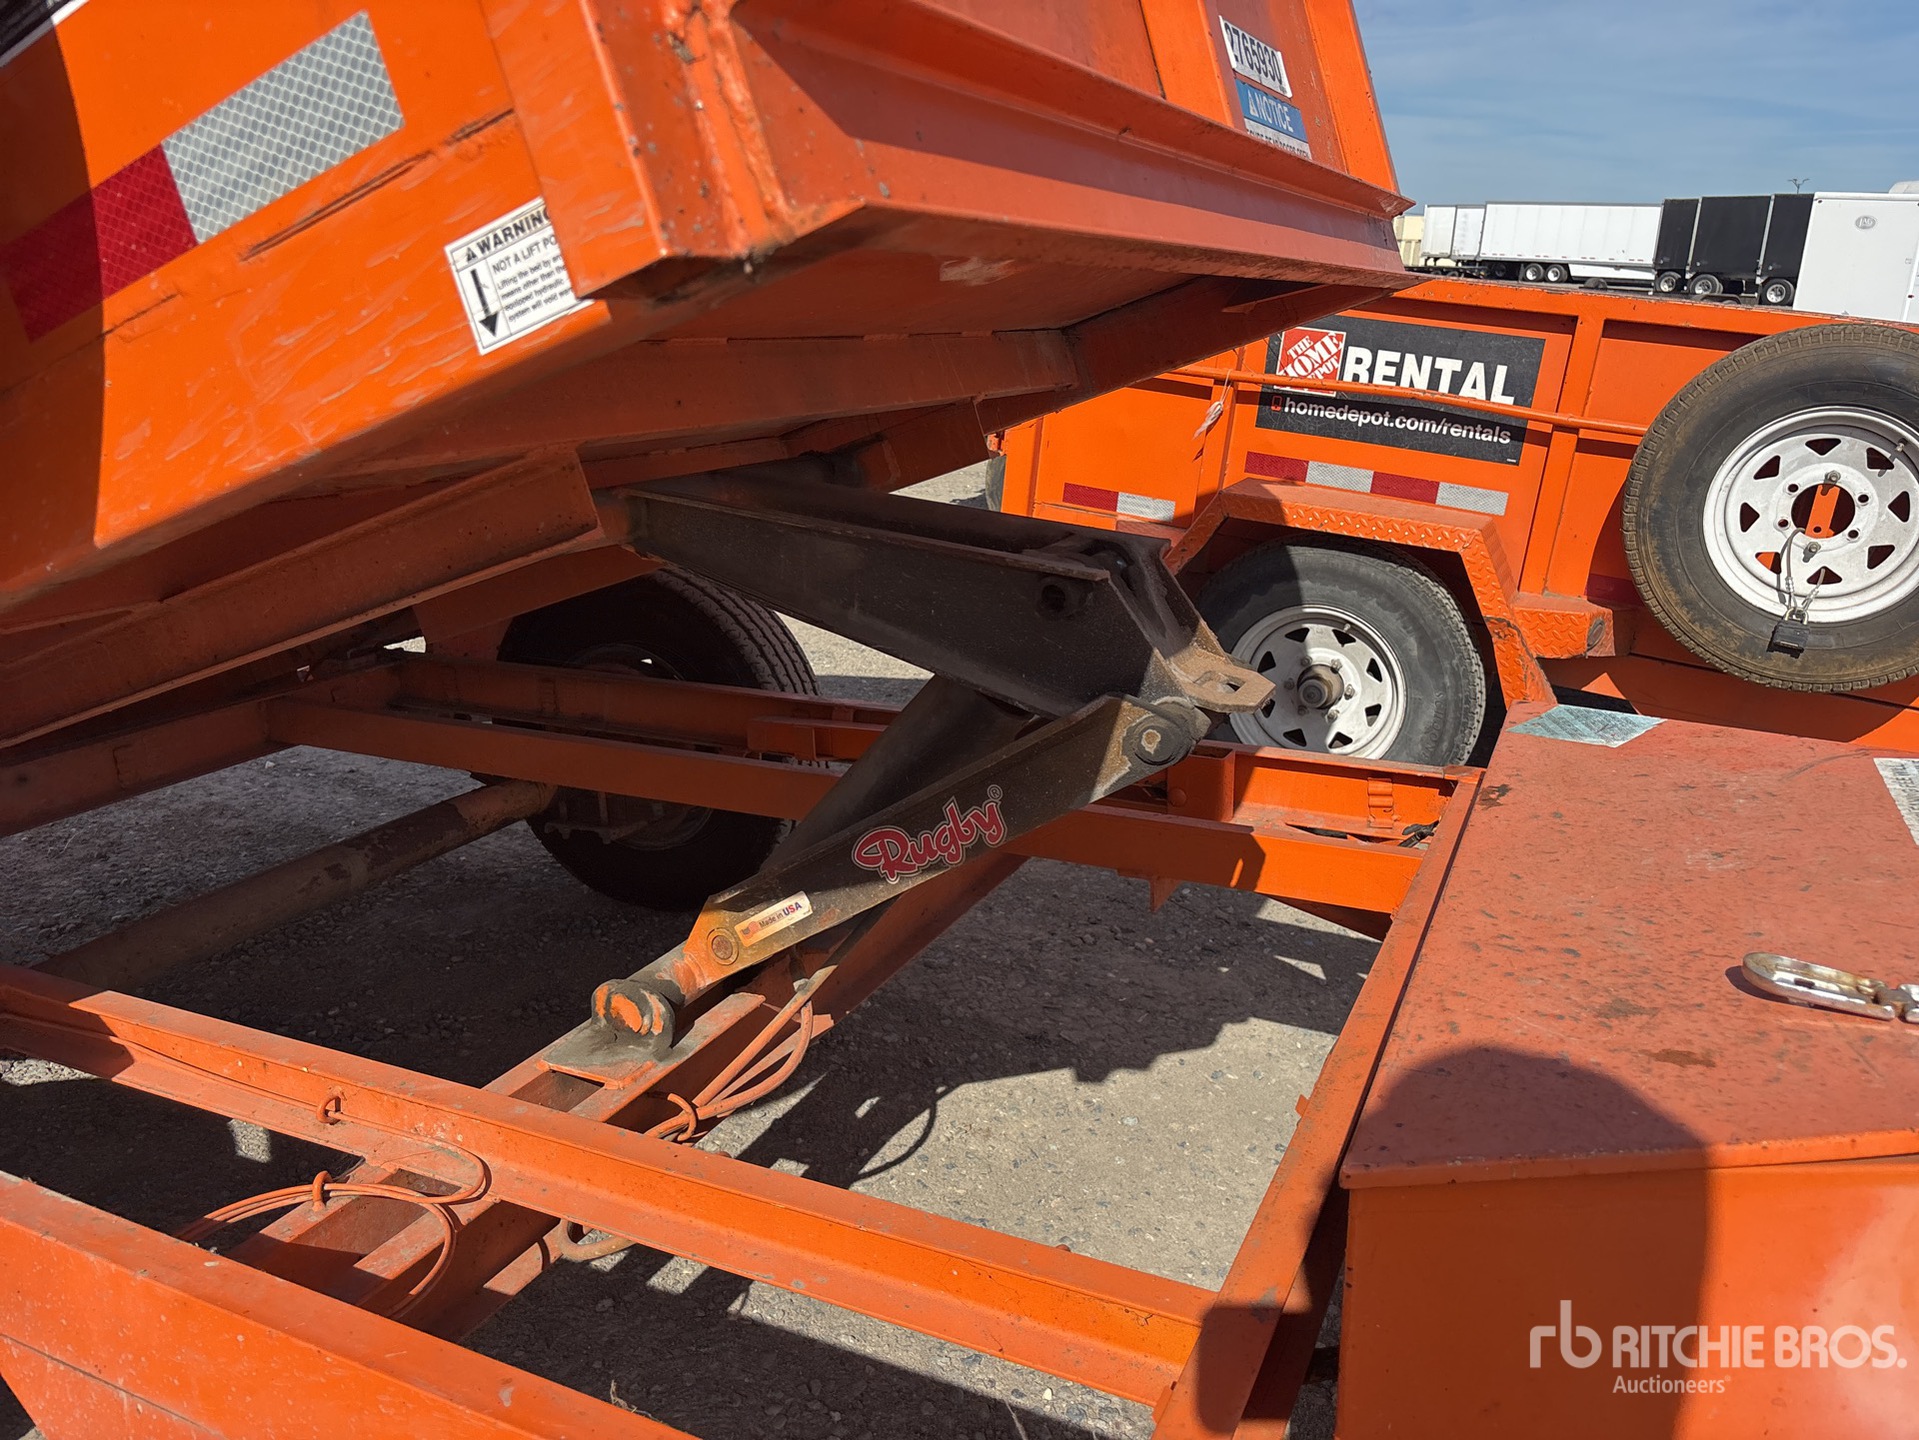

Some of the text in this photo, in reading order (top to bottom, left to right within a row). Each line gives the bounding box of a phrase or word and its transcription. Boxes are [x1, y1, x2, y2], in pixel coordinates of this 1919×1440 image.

[1254, 92, 1294, 133] NOTICE
[492, 258, 512, 274] NOT
[514, 252, 522, 265] A
[522, 242, 542, 261] LIFT
[518, 269, 529, 280] the
[1287, 335, 1314, 359] THE
[1343, 346, 1515, 405] RENTAL
[1283, 397, 1512, 444] homedepot.com/rentals
[759, 913, 778, 930] Made
[776, 910, 784, 923] in
[783, 901, 802, 919] USA
